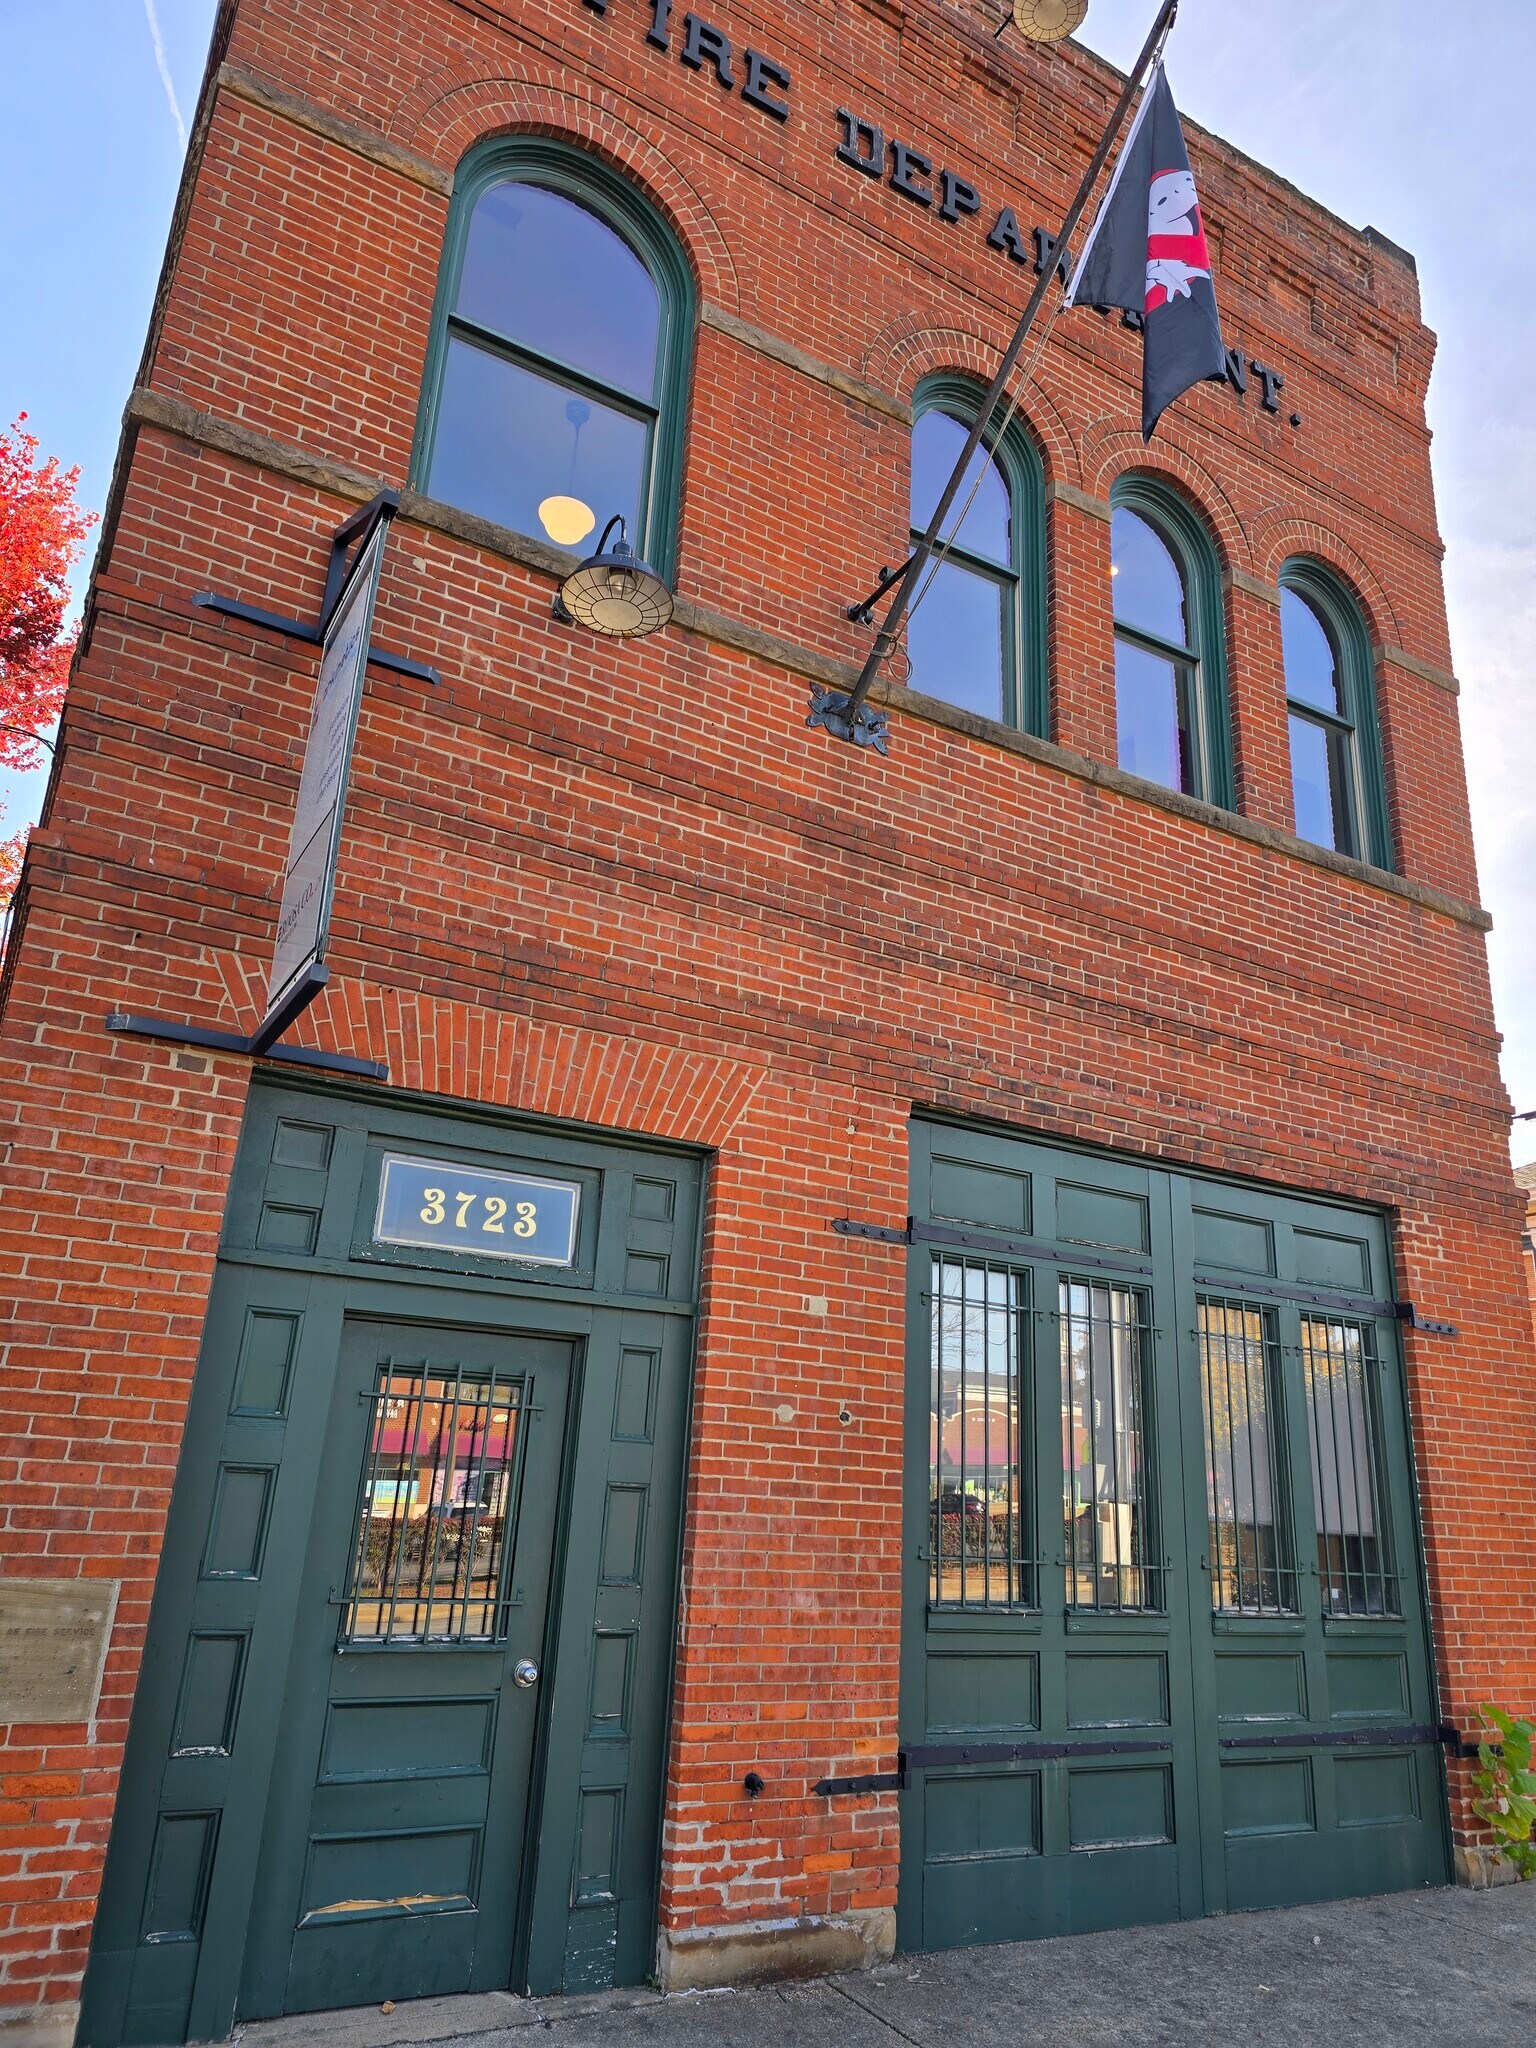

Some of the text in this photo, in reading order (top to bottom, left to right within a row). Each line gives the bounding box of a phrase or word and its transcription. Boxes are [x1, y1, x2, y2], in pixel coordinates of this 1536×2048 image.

[578, 0, 1301, 427] IRE DEPARNT.
[419, 1188, 537, 1238] 3723
[53, 1627, 96, 1637] SERVICE
